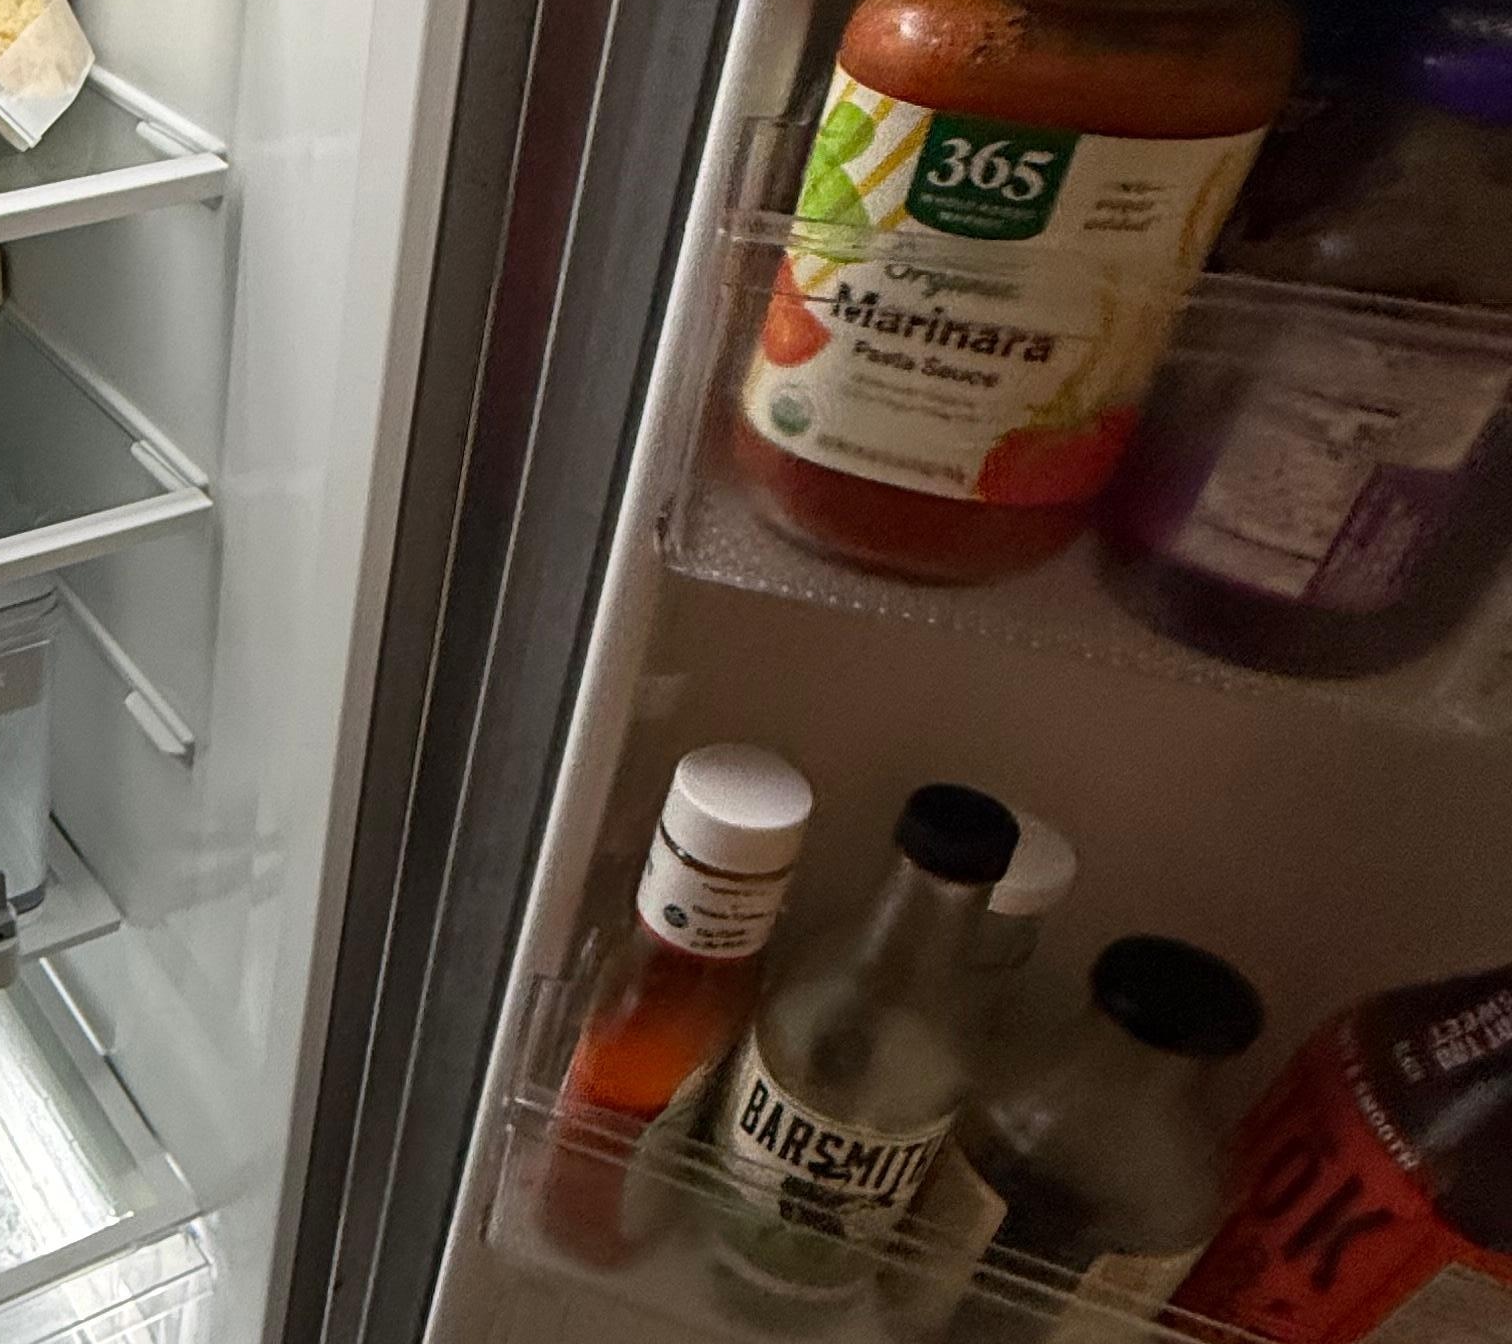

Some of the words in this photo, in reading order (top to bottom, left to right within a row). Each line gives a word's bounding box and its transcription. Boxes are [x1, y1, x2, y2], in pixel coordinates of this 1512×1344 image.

[927, 137, 1055, 202] 365
[830, 282, 1056, 364] Marinara
[852, 338, 914, 372] Pasta
[920, 355, 1000, 389] Sauce
[1355, 1080, 1422, 1173] SMOOTH
